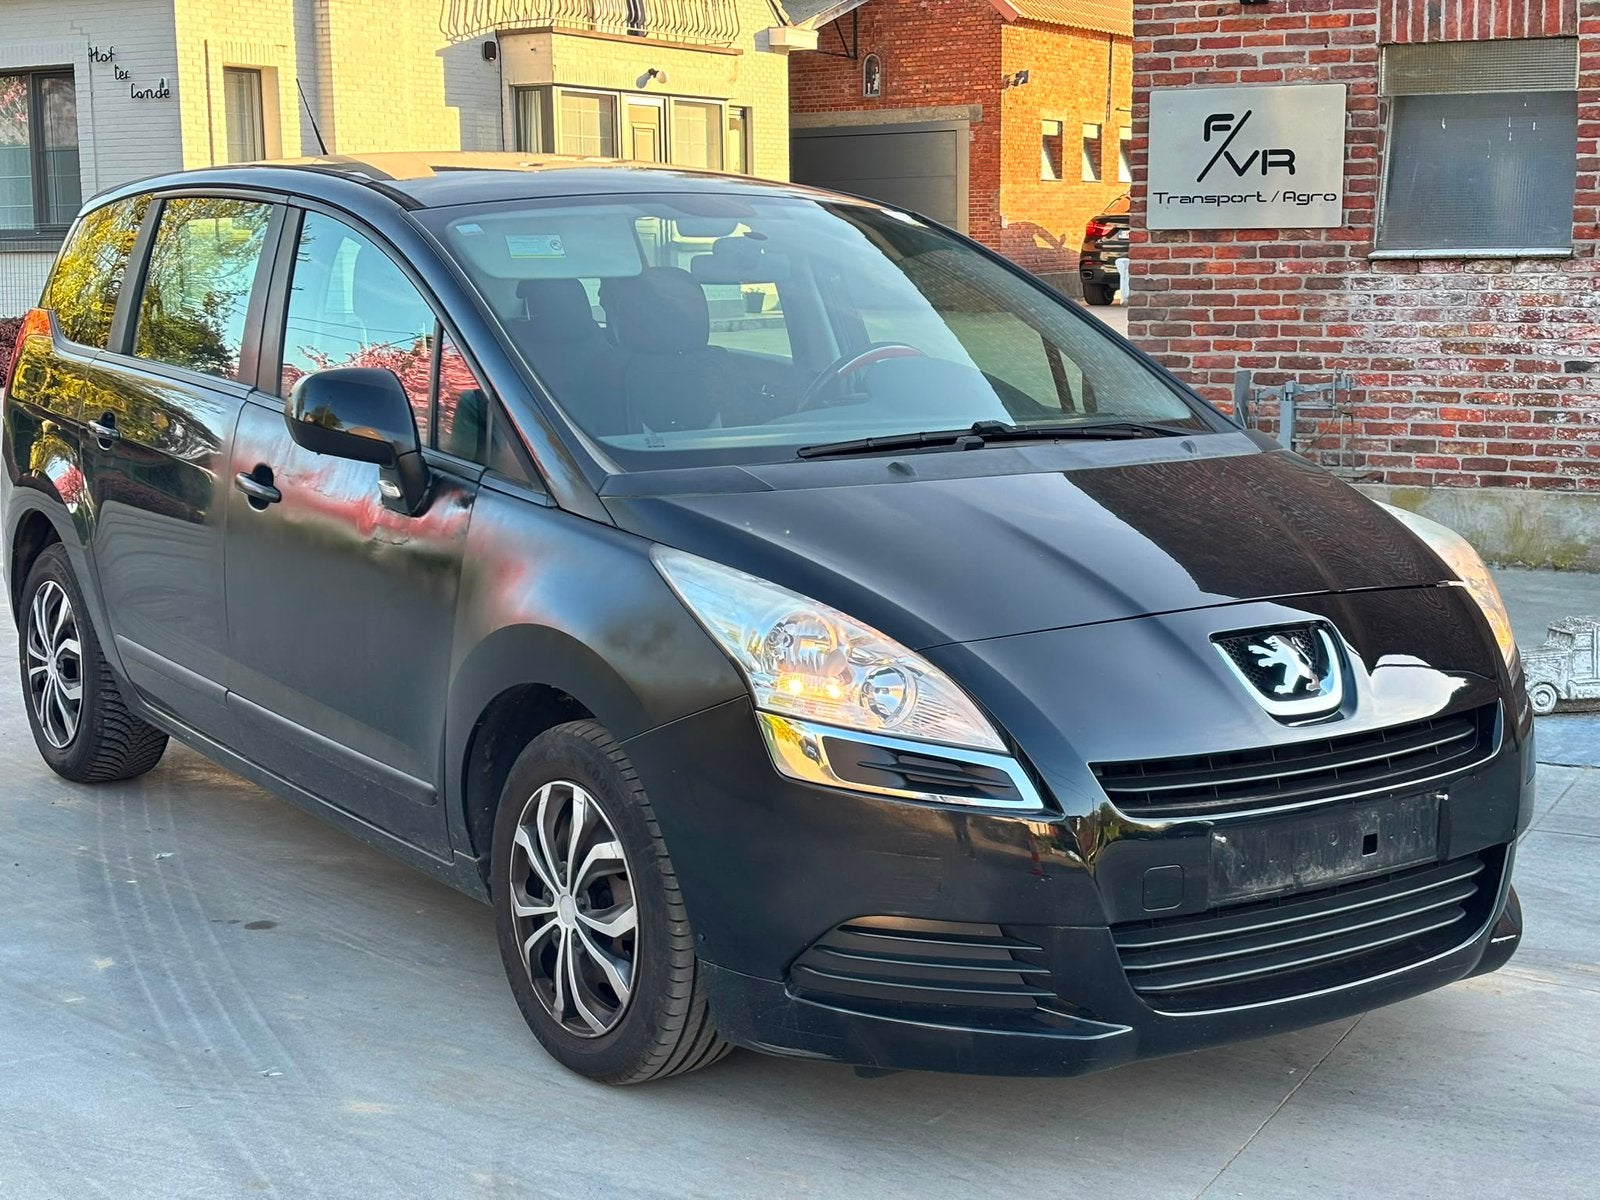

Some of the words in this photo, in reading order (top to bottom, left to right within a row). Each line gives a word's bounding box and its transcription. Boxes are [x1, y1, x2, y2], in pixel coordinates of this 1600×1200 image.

[88, 46, 116, 62] Hof
[114, 64, 131, 80] ter
[1152, 191, 1267, 207] Transport
